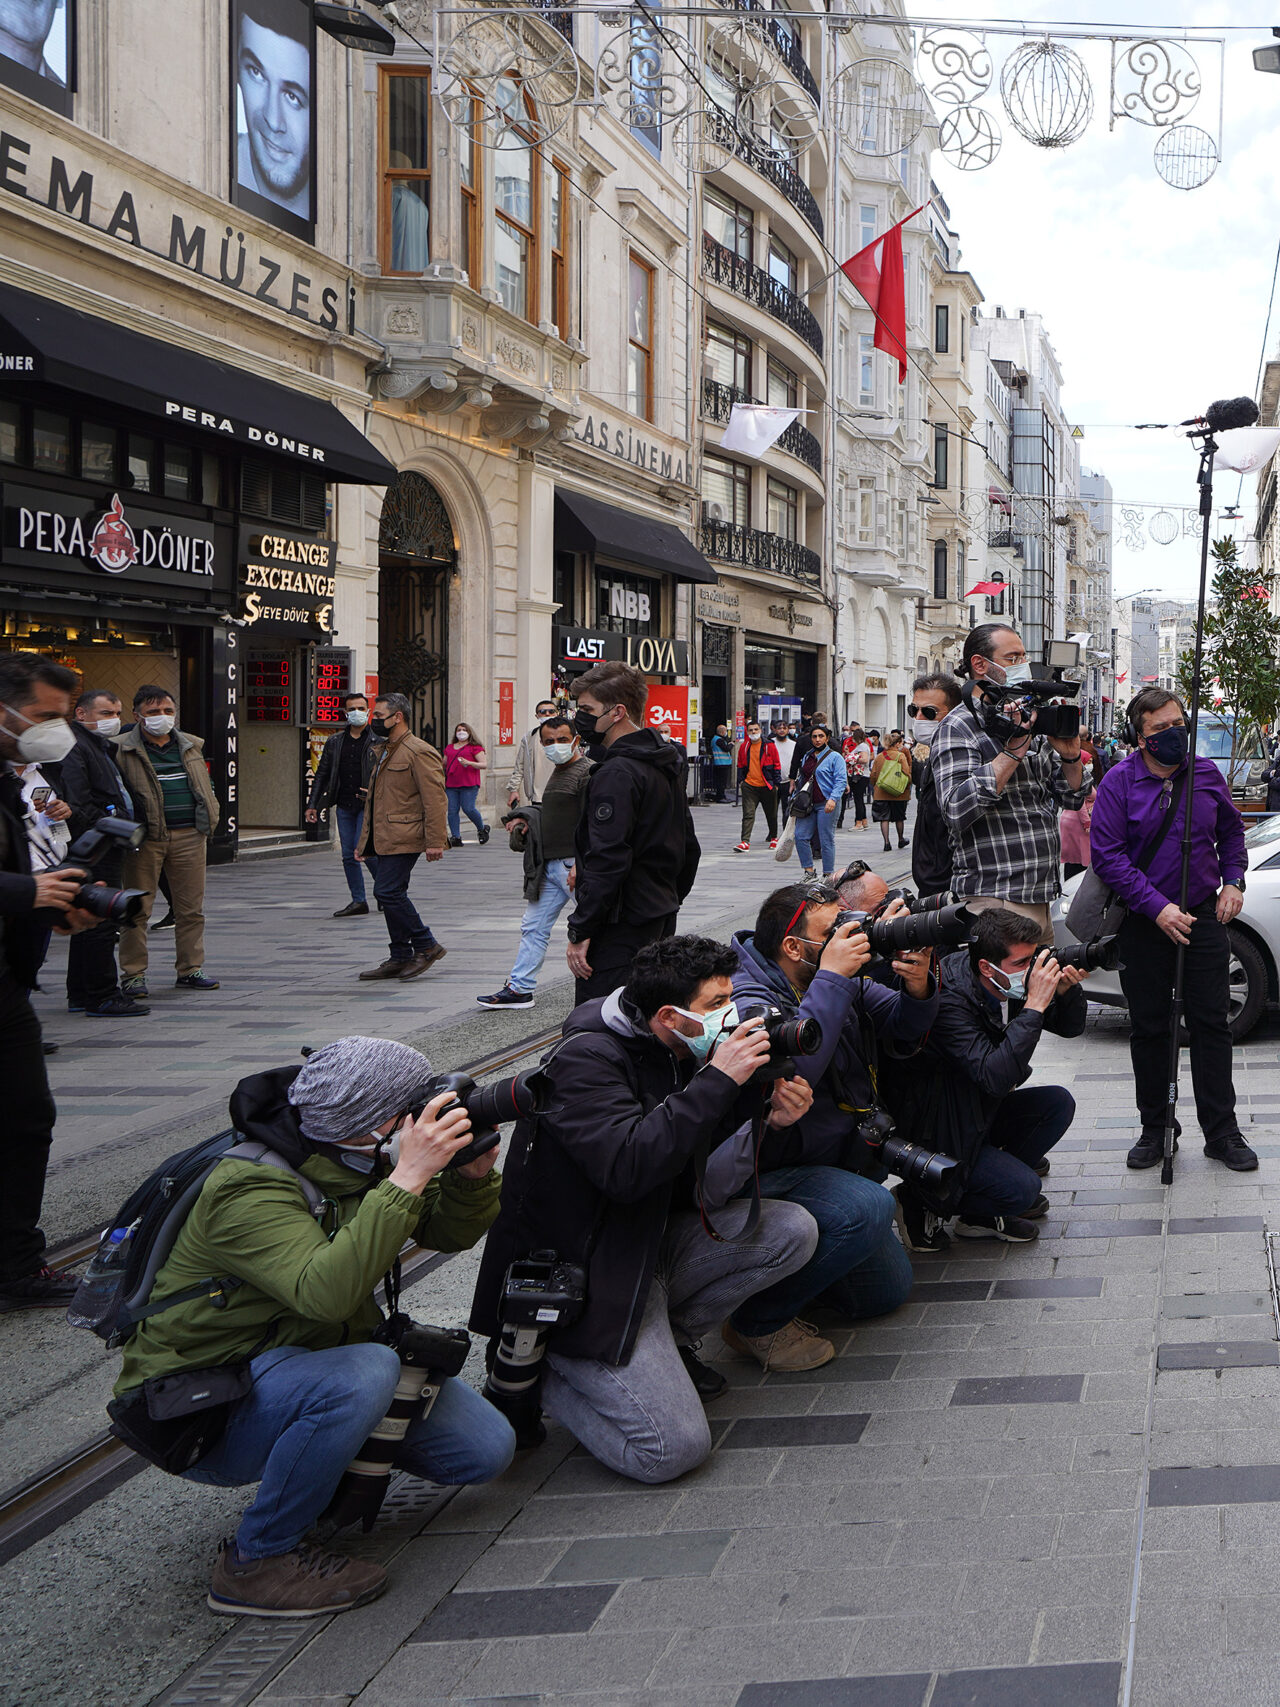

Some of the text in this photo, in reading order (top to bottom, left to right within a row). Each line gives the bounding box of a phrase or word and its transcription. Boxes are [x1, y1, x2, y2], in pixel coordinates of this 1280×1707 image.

[168, 214, 357, 335] MÜZESİ
[165, 400, 327, 463] PERA DÖNER
[574, 415, 609, 451] AS
[19, 507, 215, 576] PERA DÖNER
[260, 534, 330, 568] CHANGE
[244, 564, 336, 597] EXCHANGE
[283, 606, 310, 623] DÖVİZ
[566, 636, 605, 659] LAST
[626, 636, 678, 673] LOYA
